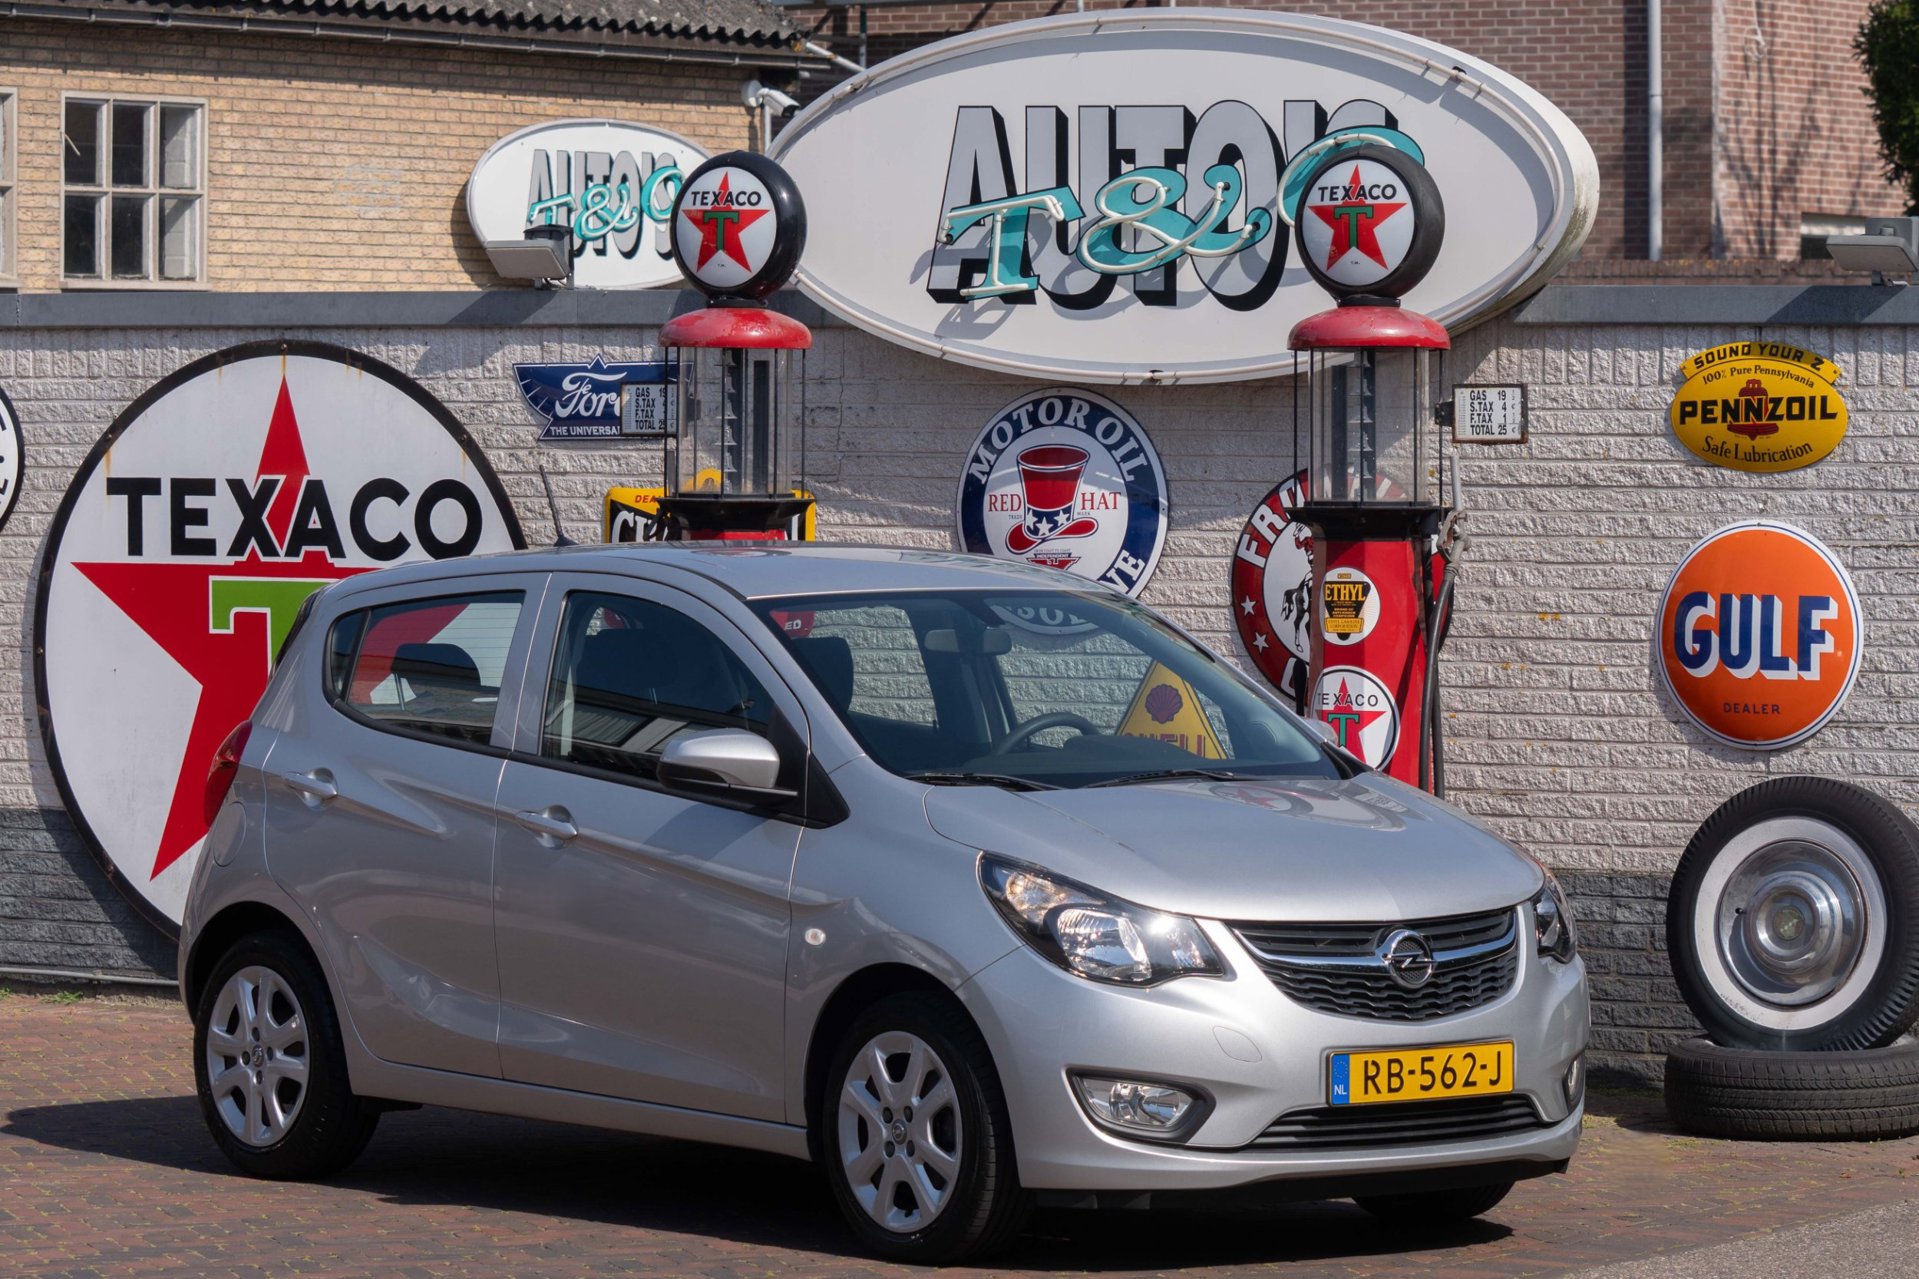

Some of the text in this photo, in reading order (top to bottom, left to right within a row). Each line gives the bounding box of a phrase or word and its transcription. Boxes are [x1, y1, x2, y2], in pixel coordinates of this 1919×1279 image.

[691, 190, 762, 207] TEXACO
[1318, 184, 1397, 202] TEXACO
[703, 211, 740, 251] T
[1333, 206, 1374, 249] T
[1693, 344, 1751, 369] SOUND
[1758, 344, 1804, 364] YOUR
[1730, 367, 1753, 377] Pure
[1754, 364, 1815, 389] Pennsylvania
[635, 387, 651, 398] GAS
[1469, 390, 1507, 401] GAS 19
[635, 398, 656, 409] S.TAX
[1469, 401, 1507, 413] S.TAX 4
[1679, 395, 1838, 426] PENNZOIL
[635, 409, 655, 420] F.TAX
[1470, 413, 1493, 424] F.TAX
[551, 426, 569, 436] THE
[635, 419, 656, 430] TOTAL
[1470, 425, 1508, 436] TOTAL 25
[969, 397, 1148, 485] MOTOR OIL
[1702, 435, 1814, 463] Safe Lubrication
[988, 491, 1122, 512] RED HAT
[106, 475, 483, 561] TEXACO
[1325, 583, 1366, 601] ETHYL
[1674, 591, 1838, 681] GULF
[1317, 692, 1379, 708] TEXACO
[1723, 702, 1781, 715] DEALER
[1362, 1050, 1502, 1096] RB-562-J
[1334, 1084, 1348, 1096] NL
